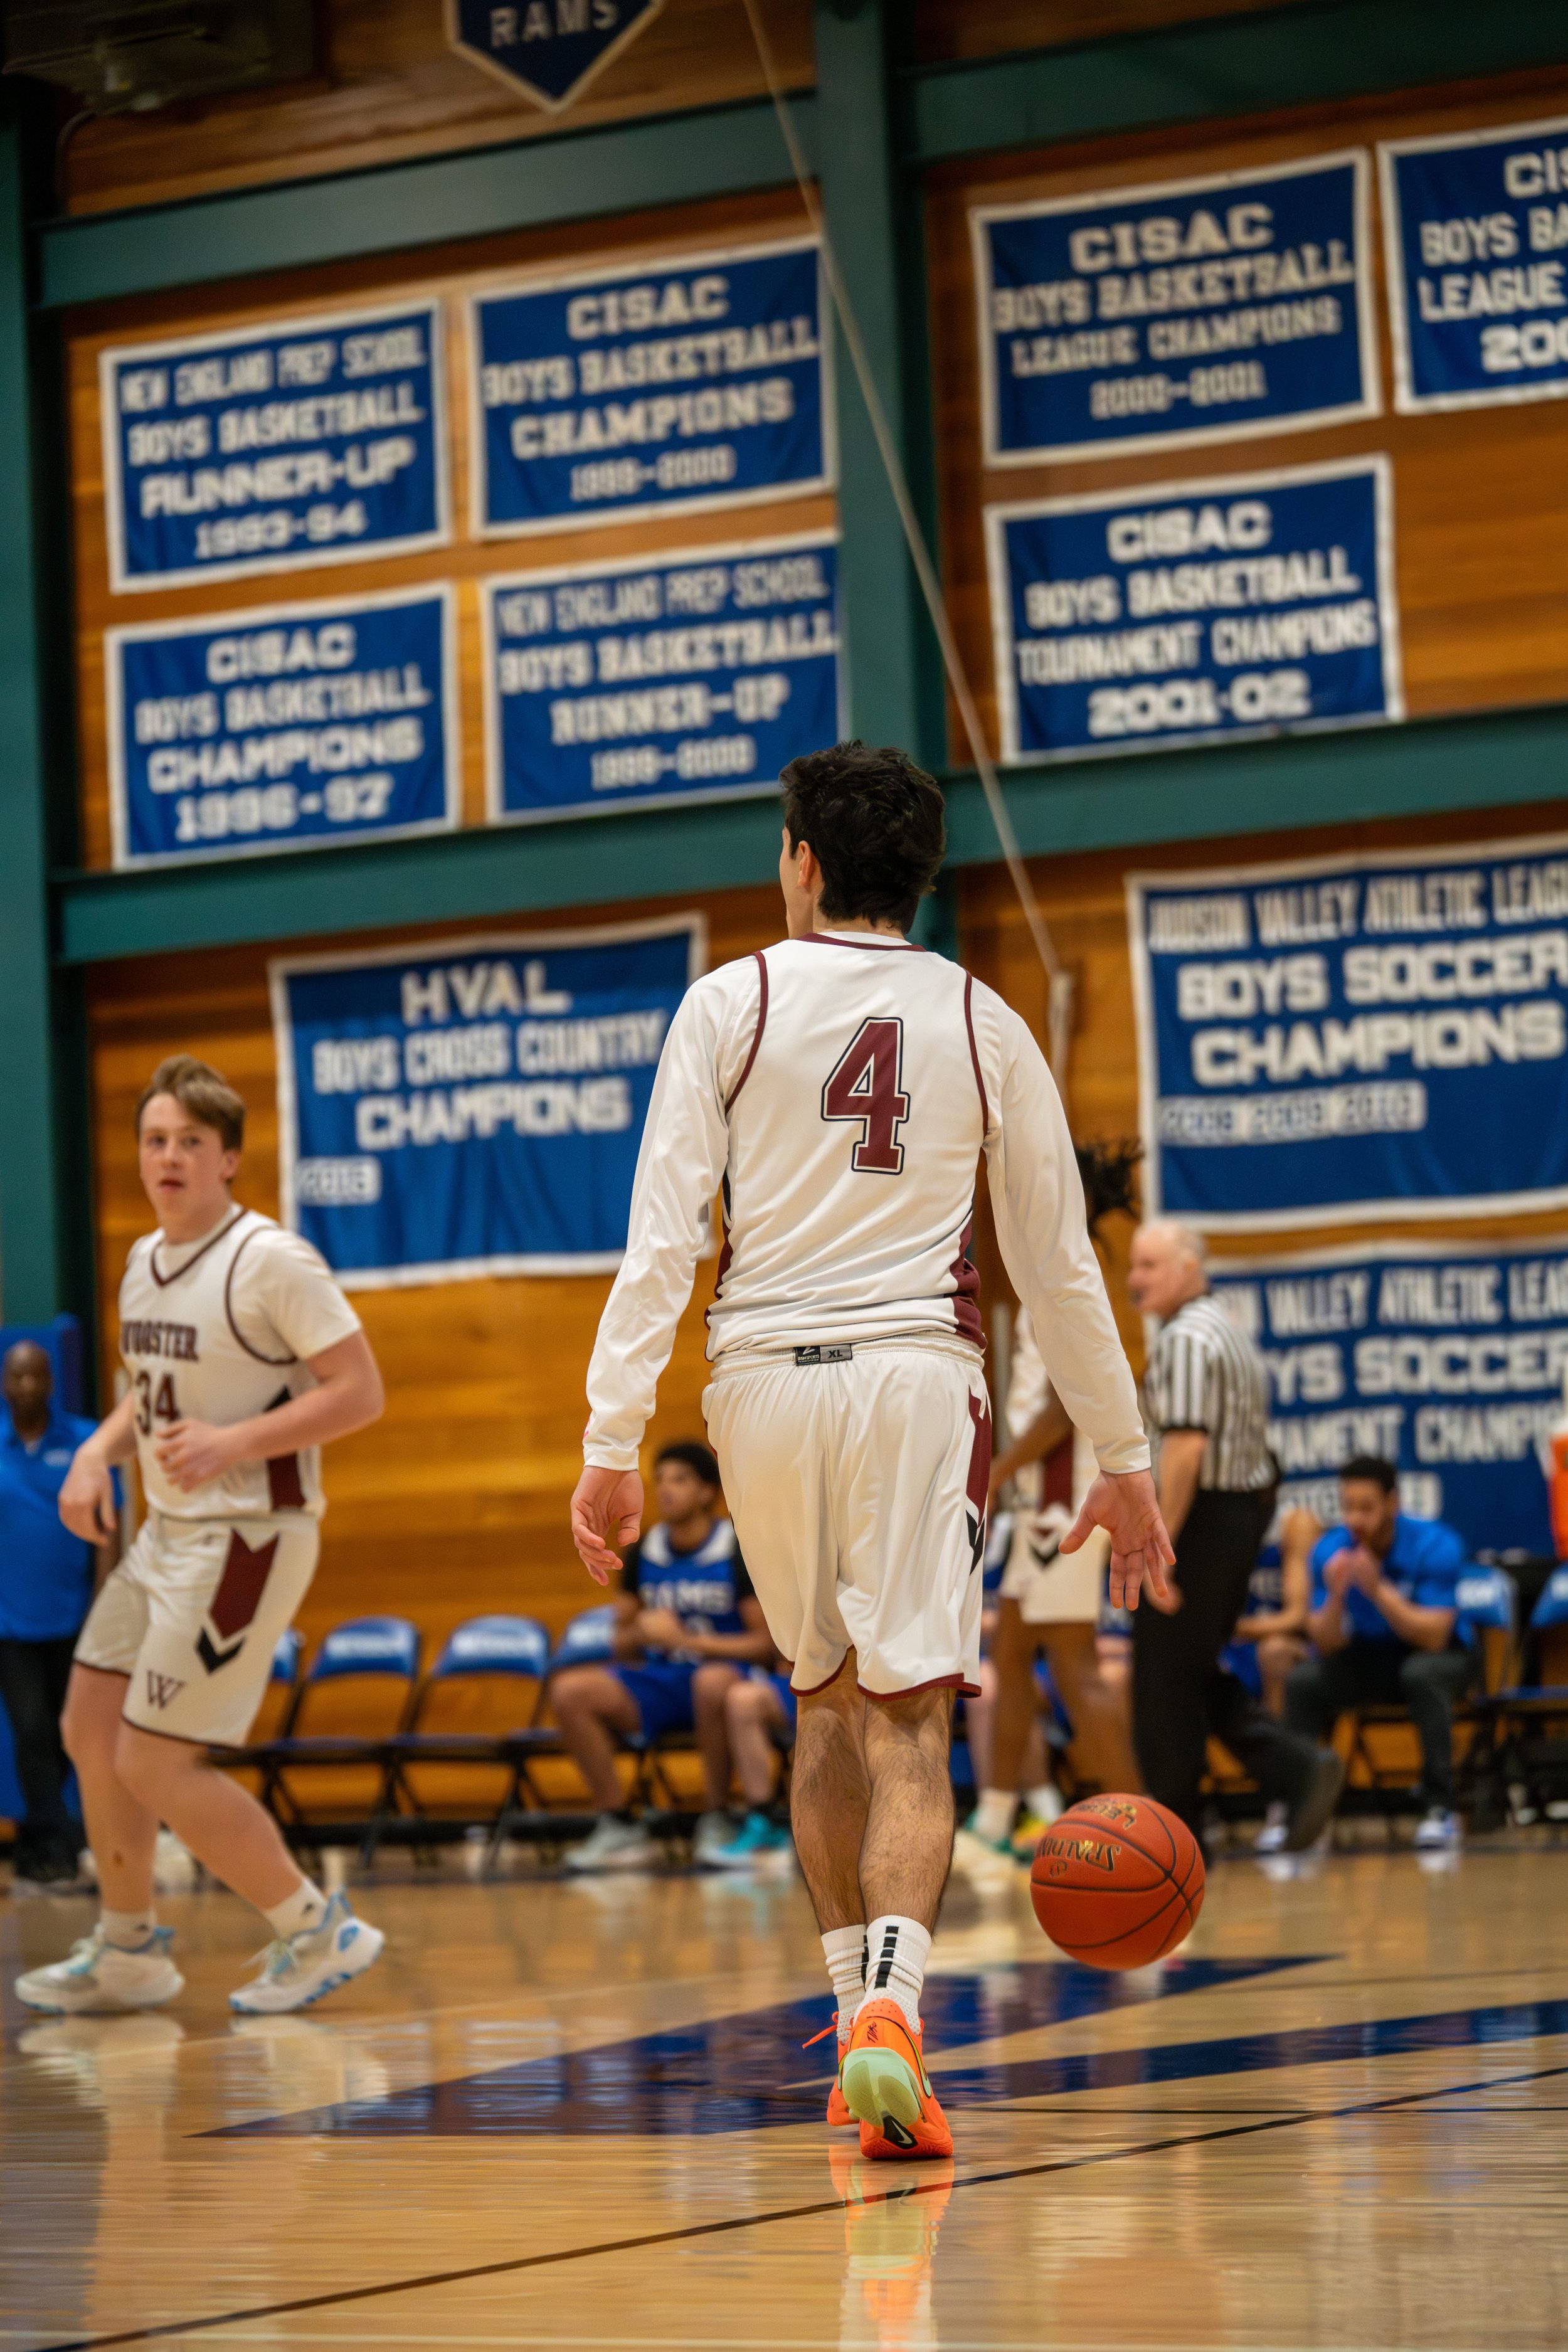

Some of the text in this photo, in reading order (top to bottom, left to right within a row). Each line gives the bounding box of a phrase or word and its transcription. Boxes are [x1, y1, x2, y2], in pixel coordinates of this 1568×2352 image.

[490, 0, 619, 48] RAMS
[1071, 207, 1271, 271] CISAC
[1422, 215, 1516, 265] BOYS
[568, 280, 728, 337] CISAC
[995, 243, 1352, 331] BOYS BASKETBALL
[1419, 264, 1567, 320] LEAGUE
[121, 329, 423, 411] NEW ENGLAND PREP SCHOOL
[485, 319, 817, 406] BOYS BASKETBALL
[1012, 299, 1338, 374] LEAGUE CHAMPIONS
[130, 384, 422, 464] BOYS BASKETBALL
[512, 381, 792, 457] CHAMPIONS
[142, 439, 413, 517] RUNNER-UP
[1108, 504, 1269, 561] CISAC
[502, 559, 826, 636] NEW ENGLAND PREP SCHOOL
[1026, 548, 1358, 626] BOYS BASKETBALL
[208, 627, 354, 682] CISAC
[502, 613, 837, 691] BOYS BASKETBALL
[1019, 603, 1374, 684] TOURNAMENT CHAMPIONS
[137, 666, 428, 741] BOYS BASKETBALL
[552, 676, 788, 743] RUNNER-UP
[1089, 672, 1308, 736] 2001-02
[149, 719, 422, 792] CHAMPIONS
[1258, 885, 1357, 943] VALLEY
[1367, 874, 1485, 931] ATHLETIC
[403, 964, 571, 1025] HVAL
[1179, 934, 1568, 1019] BOYS SOCCER
[315, 1012, 665, 1092] BOYS CROSS COUNTRY
[1194, 1004, 1566, 1084] CHAMPIONS
[358, 1078, 628, 1148] CHAMPIONS
[821, 1017, 911, 1175] 4
[1268, 1273, 1367, 1336] VALLEY
[1379, 1268, 1501, 1324] ATHLETIC
[828, 1349, 843, 1359] XL
[1263, 1345, 1342, 1404] YS
[135, 1370, 180, 1438] 34
[1267, 1409, 1402, 1470] NAMENT
[147, 1670, 185, 1709] W
